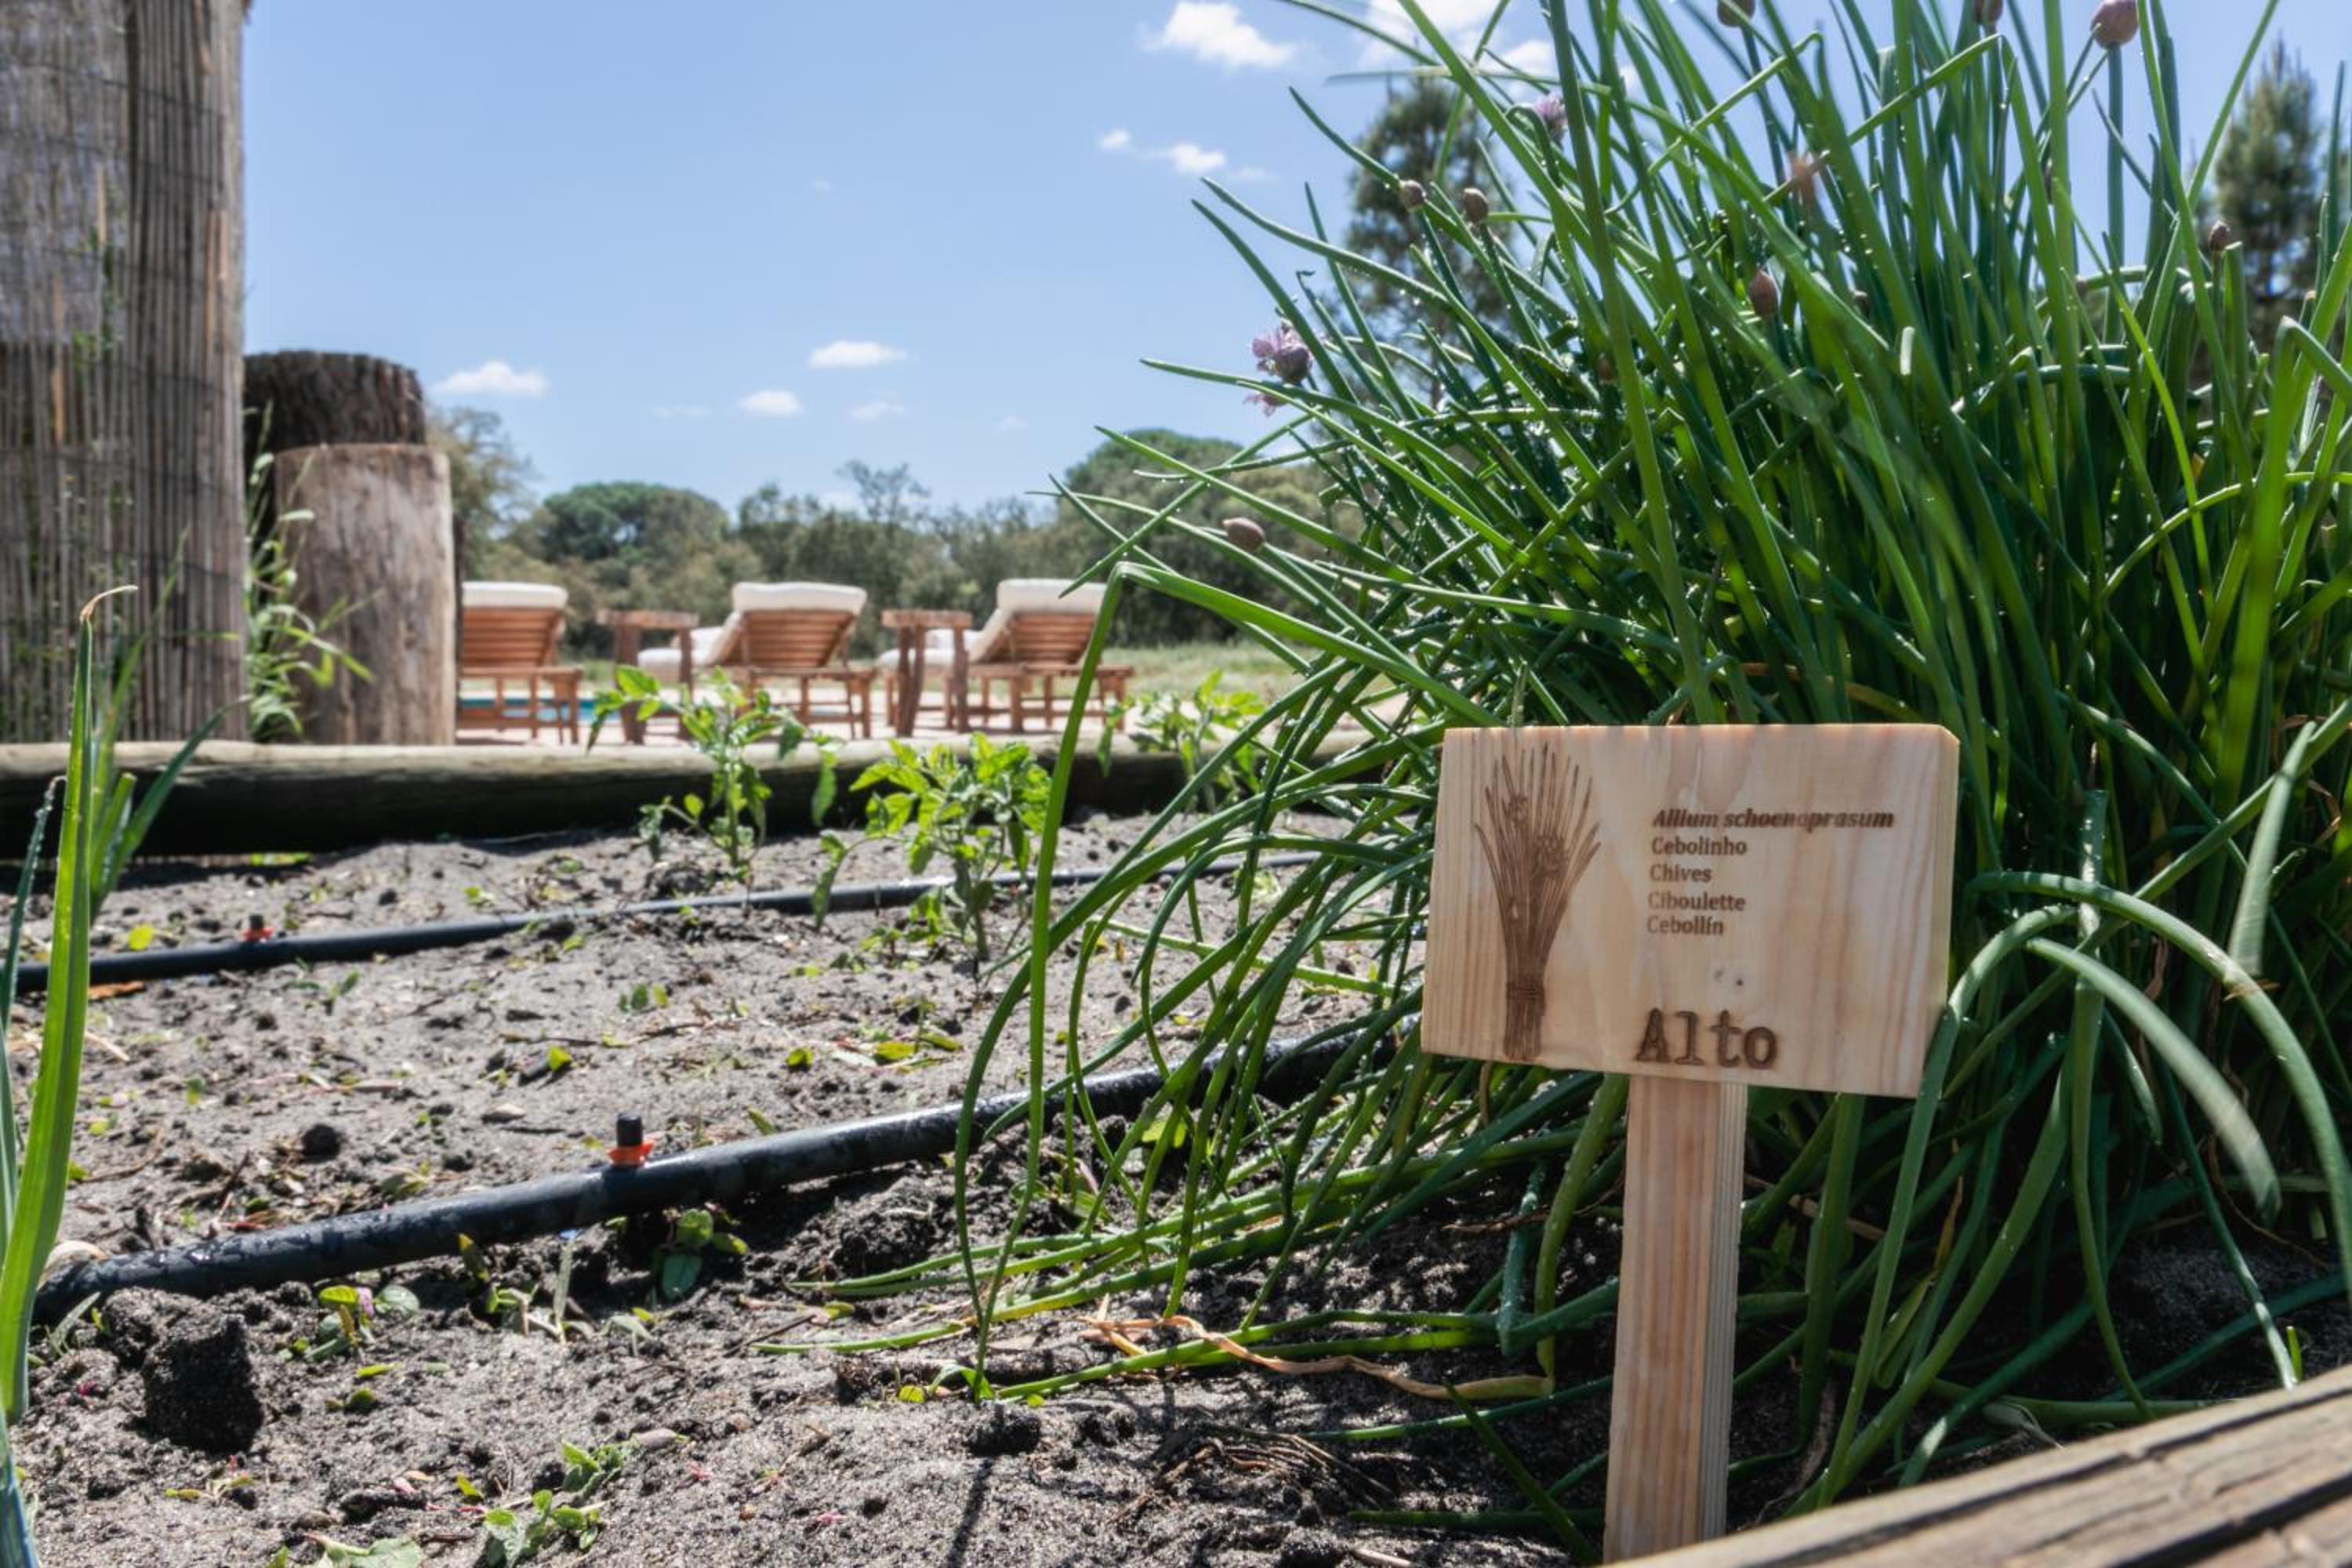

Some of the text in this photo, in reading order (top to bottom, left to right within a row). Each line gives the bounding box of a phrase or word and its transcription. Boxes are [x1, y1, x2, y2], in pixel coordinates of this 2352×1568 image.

[1651, 836, 1748, 856] Cebolinho
[1650, 864, 1711, 883] Chives
[1648, 891, 1746, 911] Ciboulette
[1635, 1007, 1779, 1069] Alto
